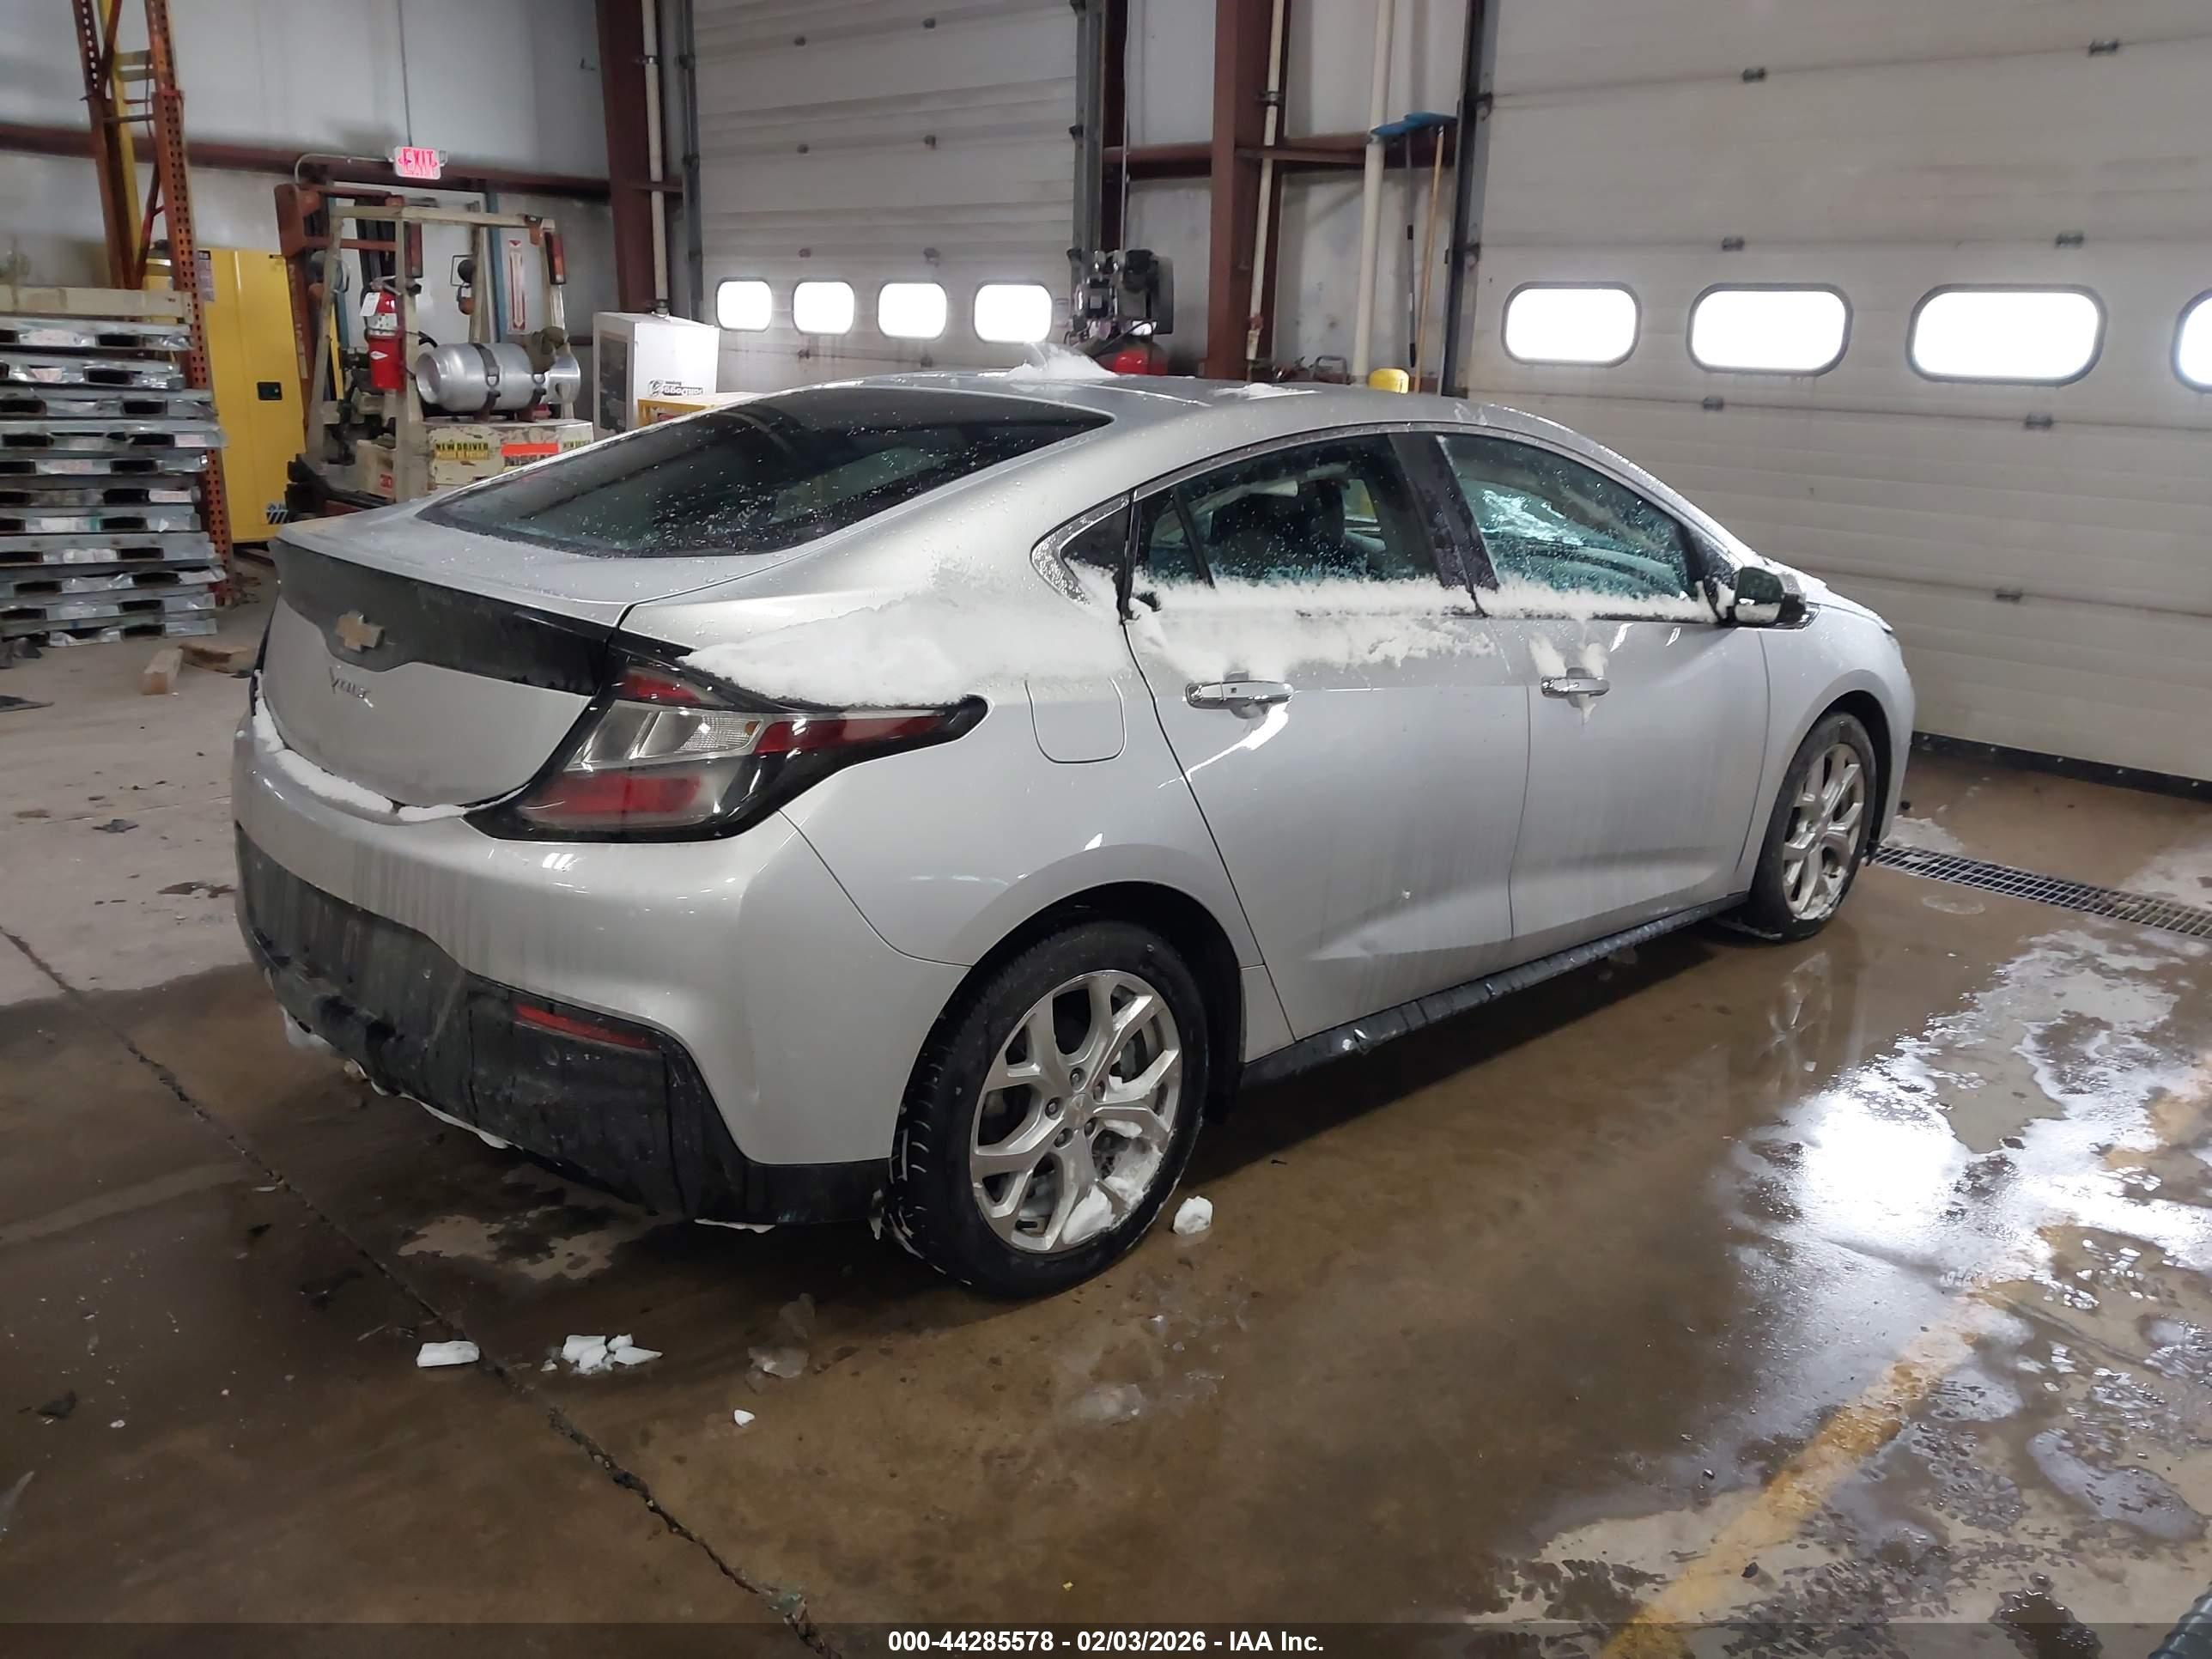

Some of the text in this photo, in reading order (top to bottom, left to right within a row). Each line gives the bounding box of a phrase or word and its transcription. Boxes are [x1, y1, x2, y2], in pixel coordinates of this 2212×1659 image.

[403, 148, 434, 176] EXIT
[435, 442, 489, 452] NEW DRIVER
